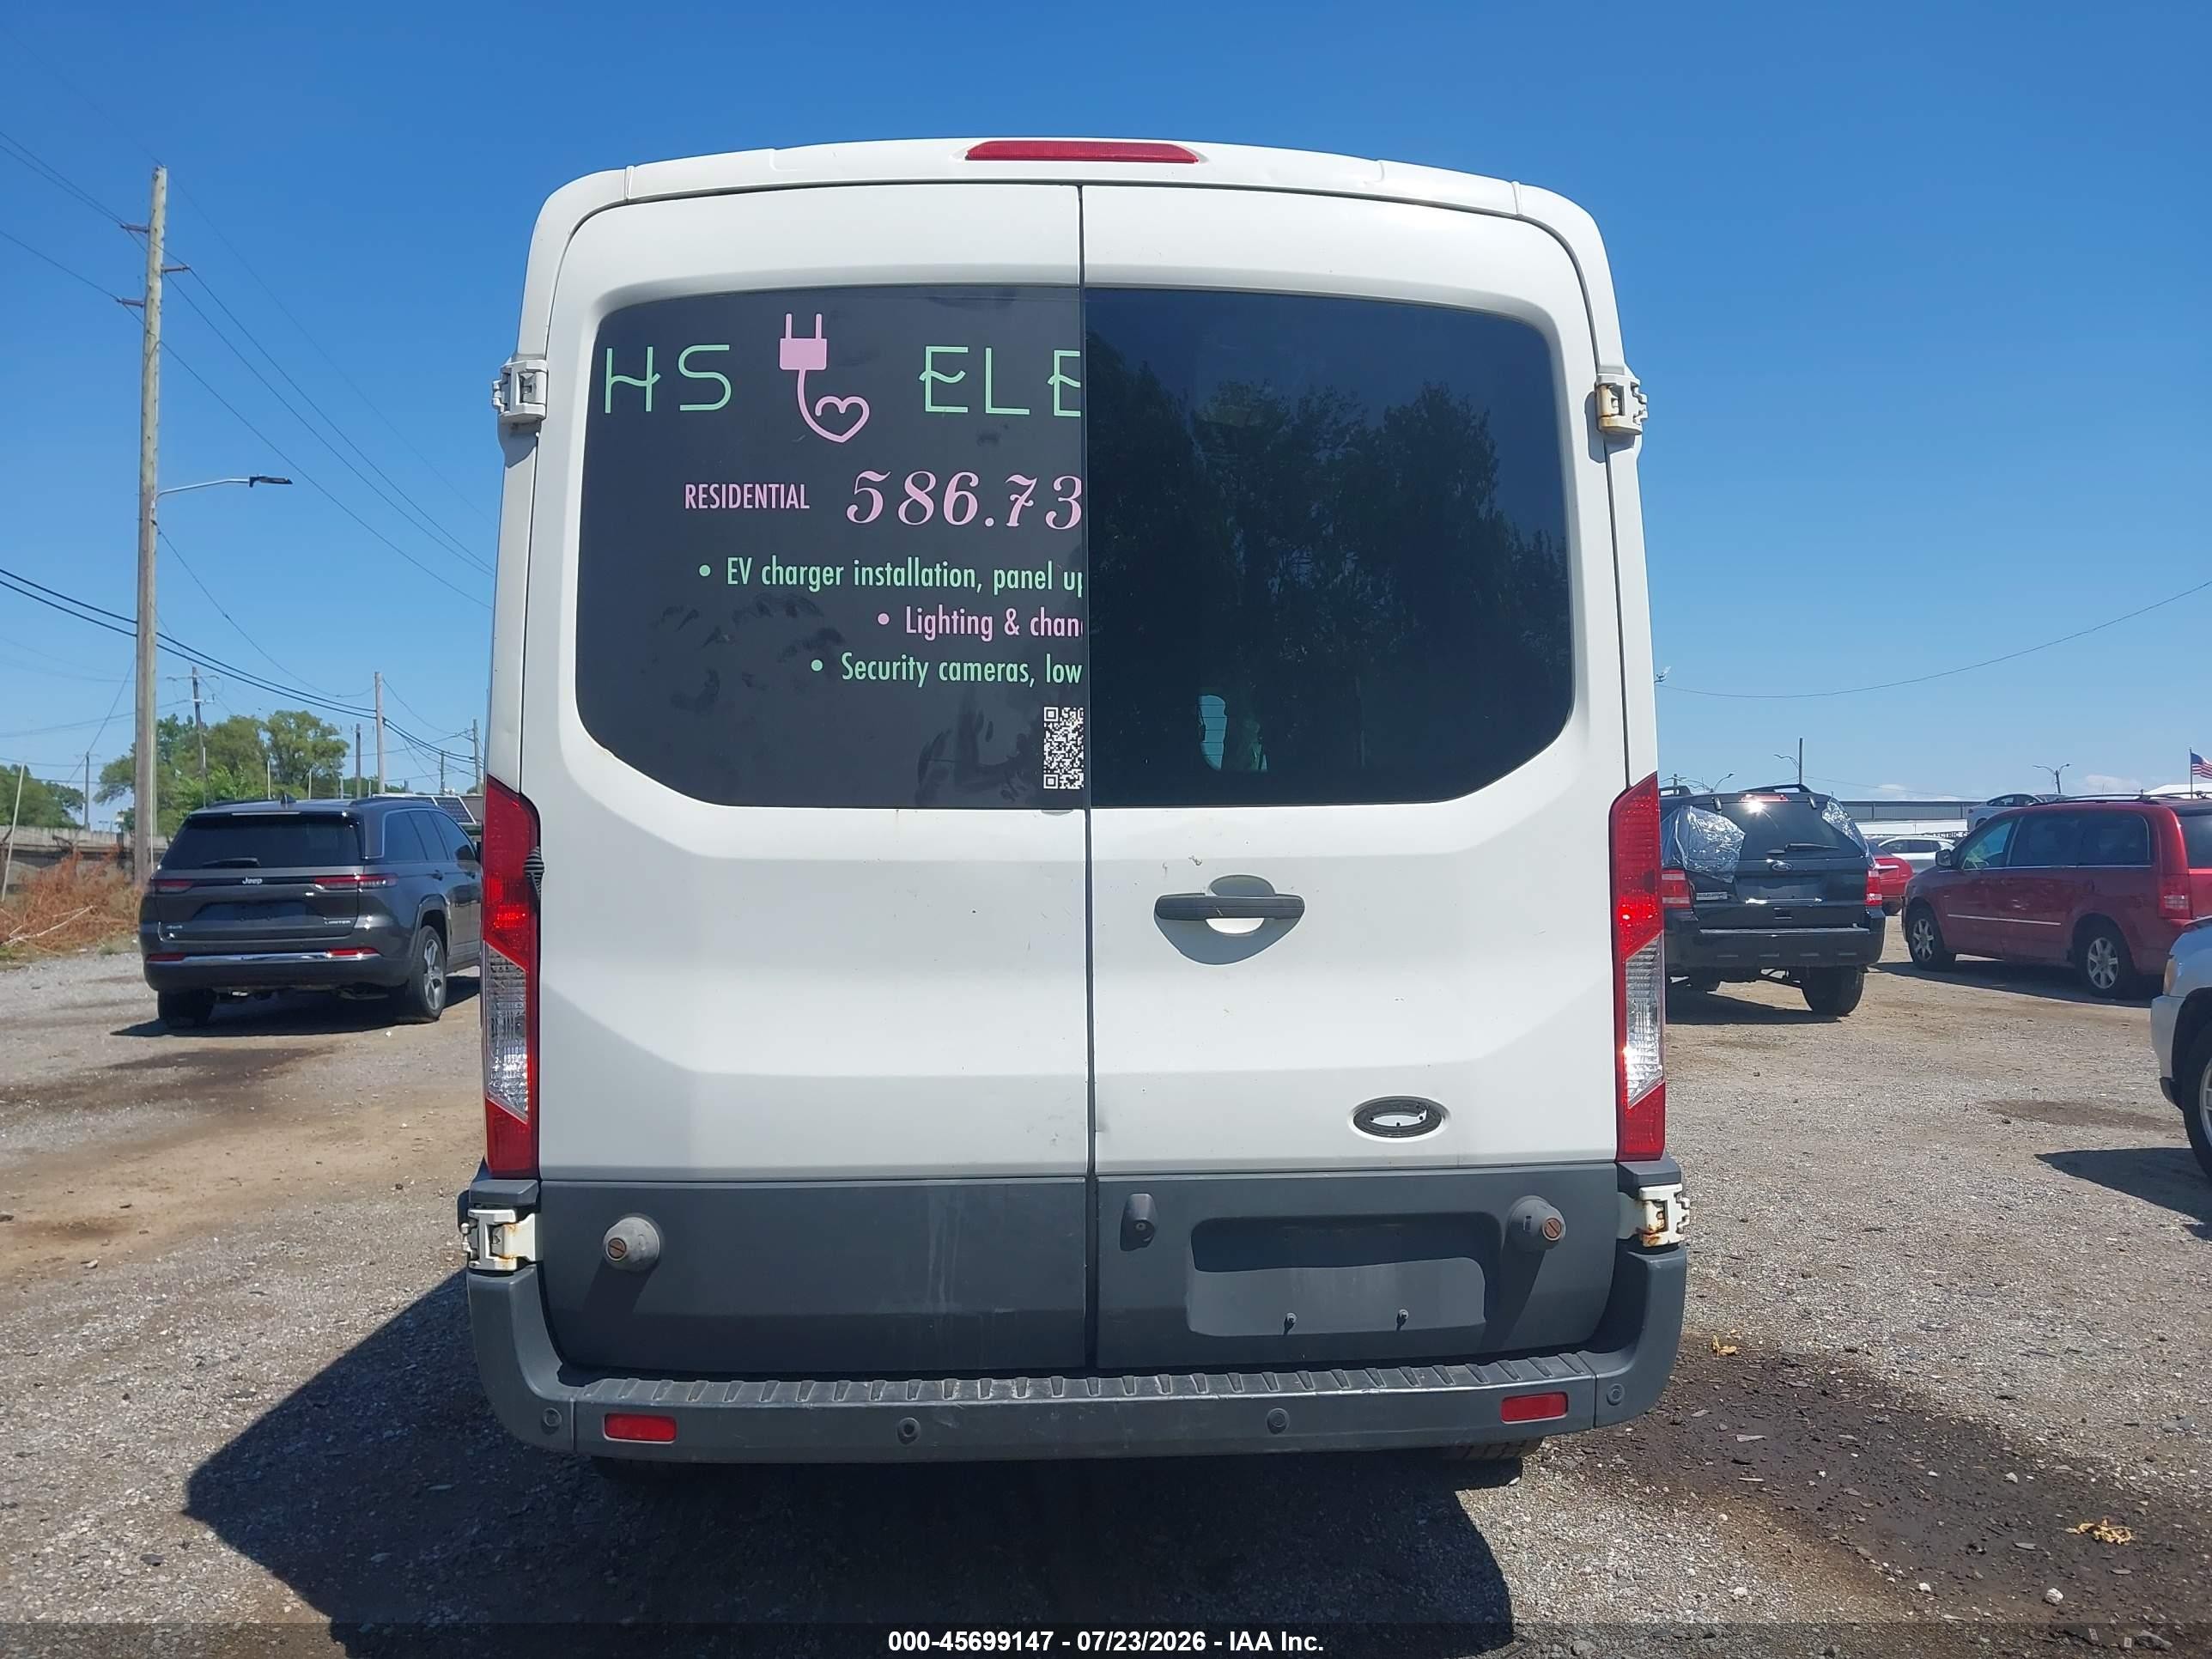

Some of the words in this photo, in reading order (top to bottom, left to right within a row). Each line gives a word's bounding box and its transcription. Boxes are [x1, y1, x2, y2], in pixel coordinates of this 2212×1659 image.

[605, 344, 732, 414] HS
[918, 345, 1082, 416] ELE
[684, 483, 811, 510] RESIDENTIAL
[846, 471, 1082, 530] 586.73
[727, 556, 752, 586] EV
[761, 555, 844, 592] charger
[854, 556, 982, 593] installation,
[994, 560, 1053, 596] panel
[906, 604, 993, 642] Lighting
[1004, 607, 1020, 635] &
[1030, 606, 1084, 637] chan
[842, 652, 929, 688] Security
[939, 661, 1035, 688] cameras,
[1046, 653, 1083, 684] low
[242, 877, 263, 885] Jeep
